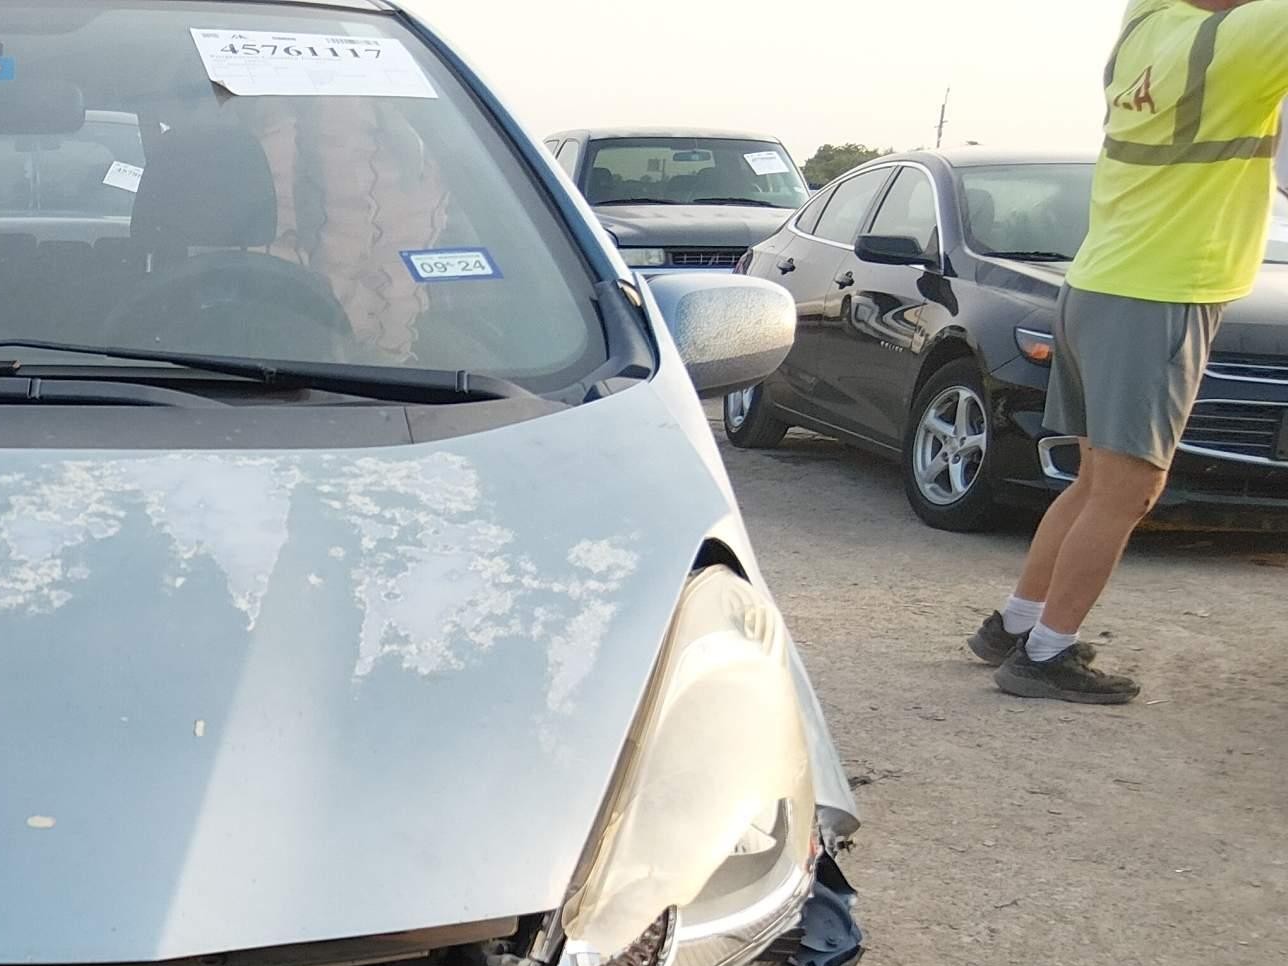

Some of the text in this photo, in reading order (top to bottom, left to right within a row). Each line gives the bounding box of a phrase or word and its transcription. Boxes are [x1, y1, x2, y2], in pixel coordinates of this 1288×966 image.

[219, 42, 382, 60] 45761117
[420, 259, 486, 274] 09 24
